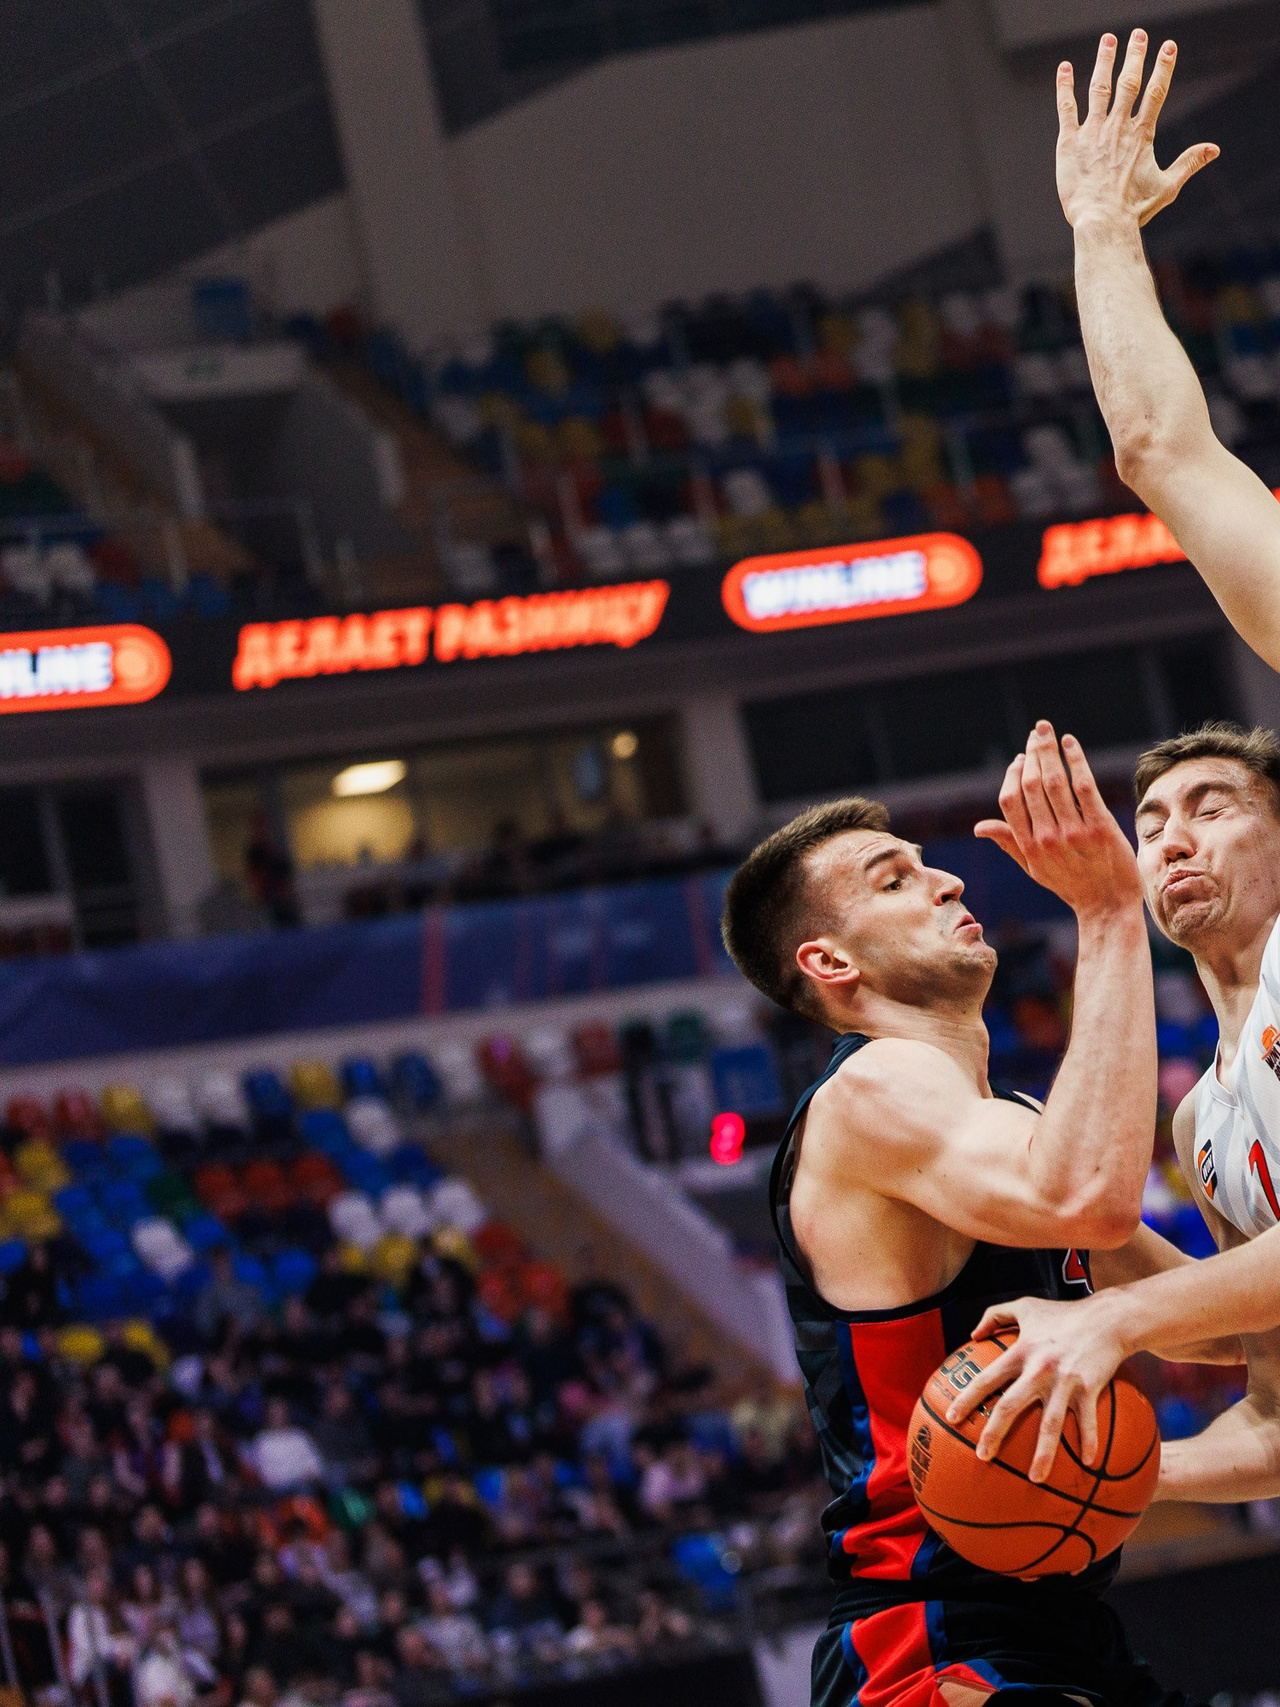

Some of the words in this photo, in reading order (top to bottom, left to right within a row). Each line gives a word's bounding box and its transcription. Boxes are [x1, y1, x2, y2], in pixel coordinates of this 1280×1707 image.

[741, 550, 928, 620] WINLINE
[232, 606, 434, 691] ДЕЛАЕТ
[434, 579, 670, 662] РАЗНИЦУ
